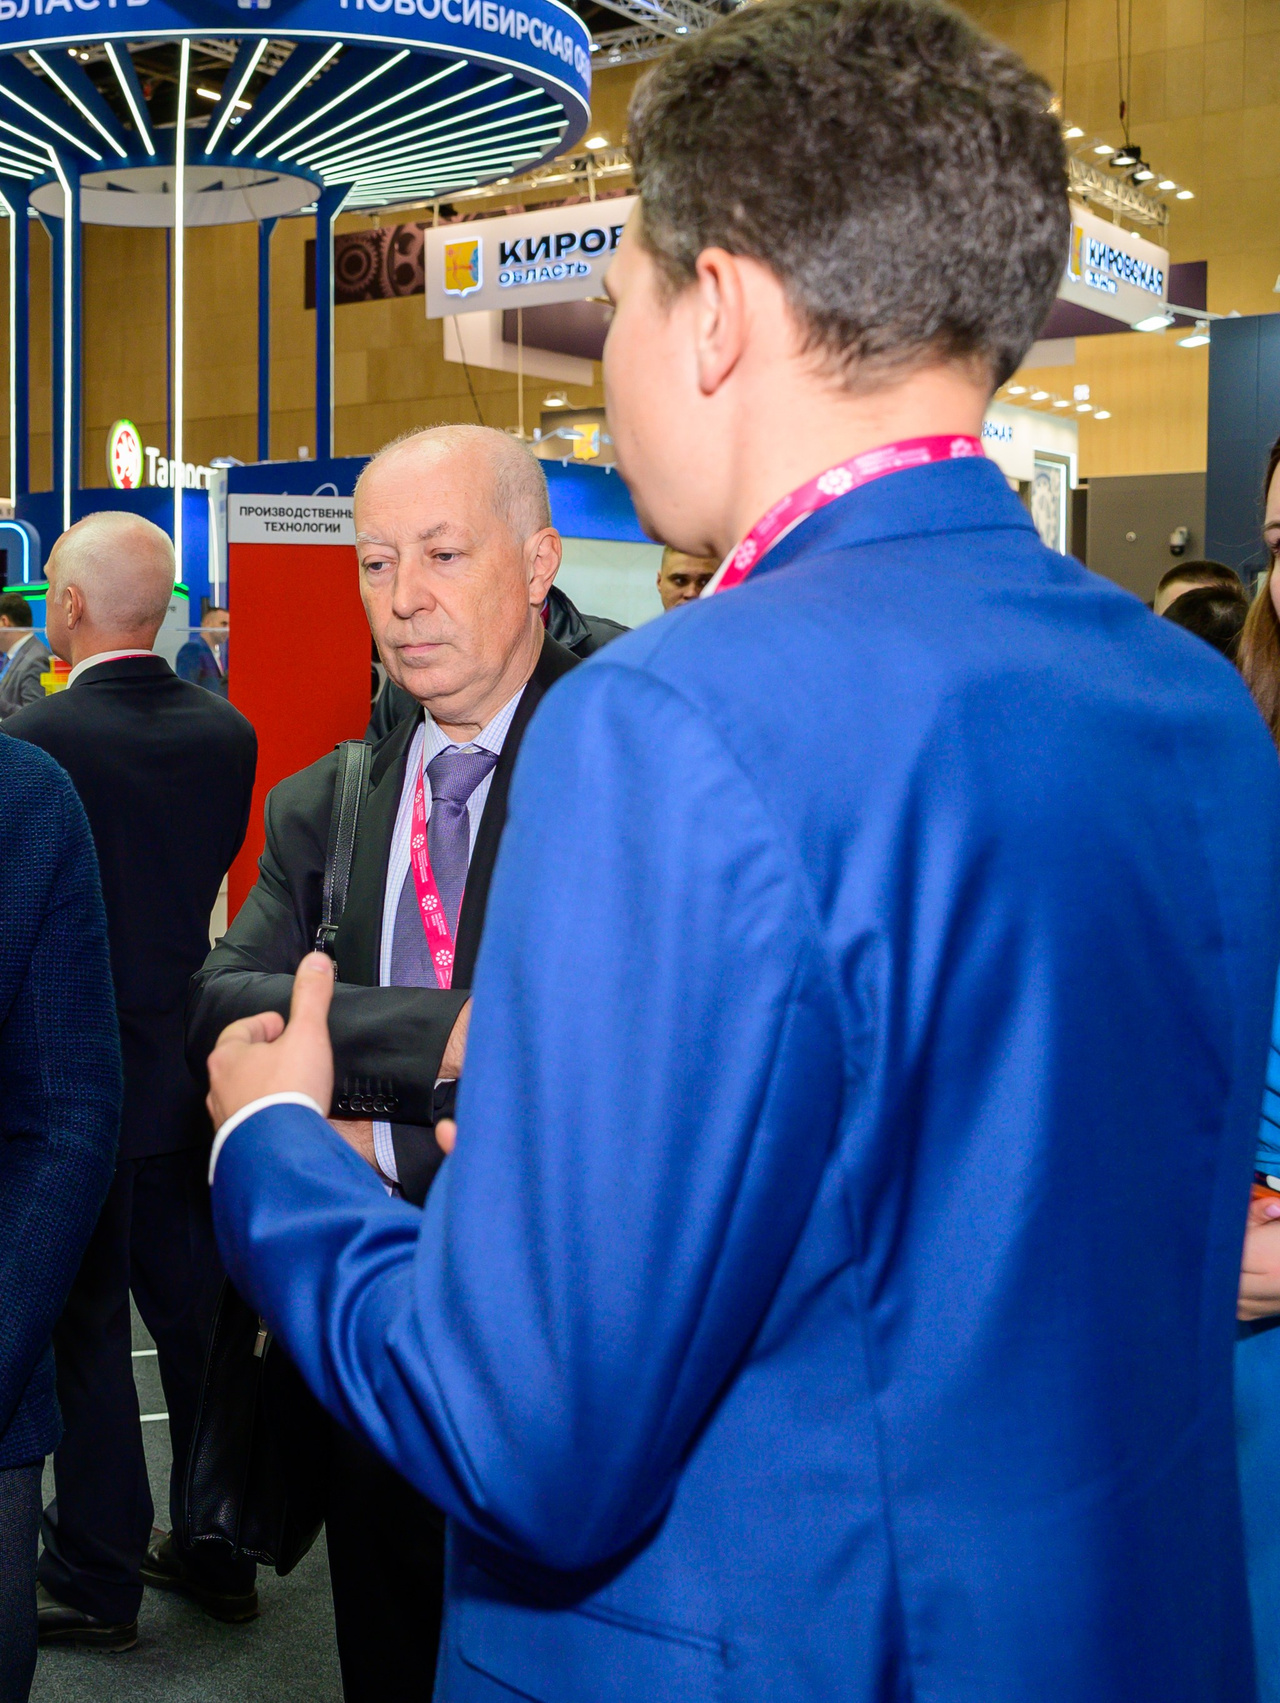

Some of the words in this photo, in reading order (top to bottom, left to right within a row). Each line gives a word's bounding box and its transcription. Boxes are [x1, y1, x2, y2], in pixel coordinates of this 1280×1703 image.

[499, 261, 590, 287] ОБЛАСТЬ
[239, 506, 354, 519] ПРОИЗВОДСТВЕНН
[264, 521, 341, 533] ТЕХНОЛОГИИ
